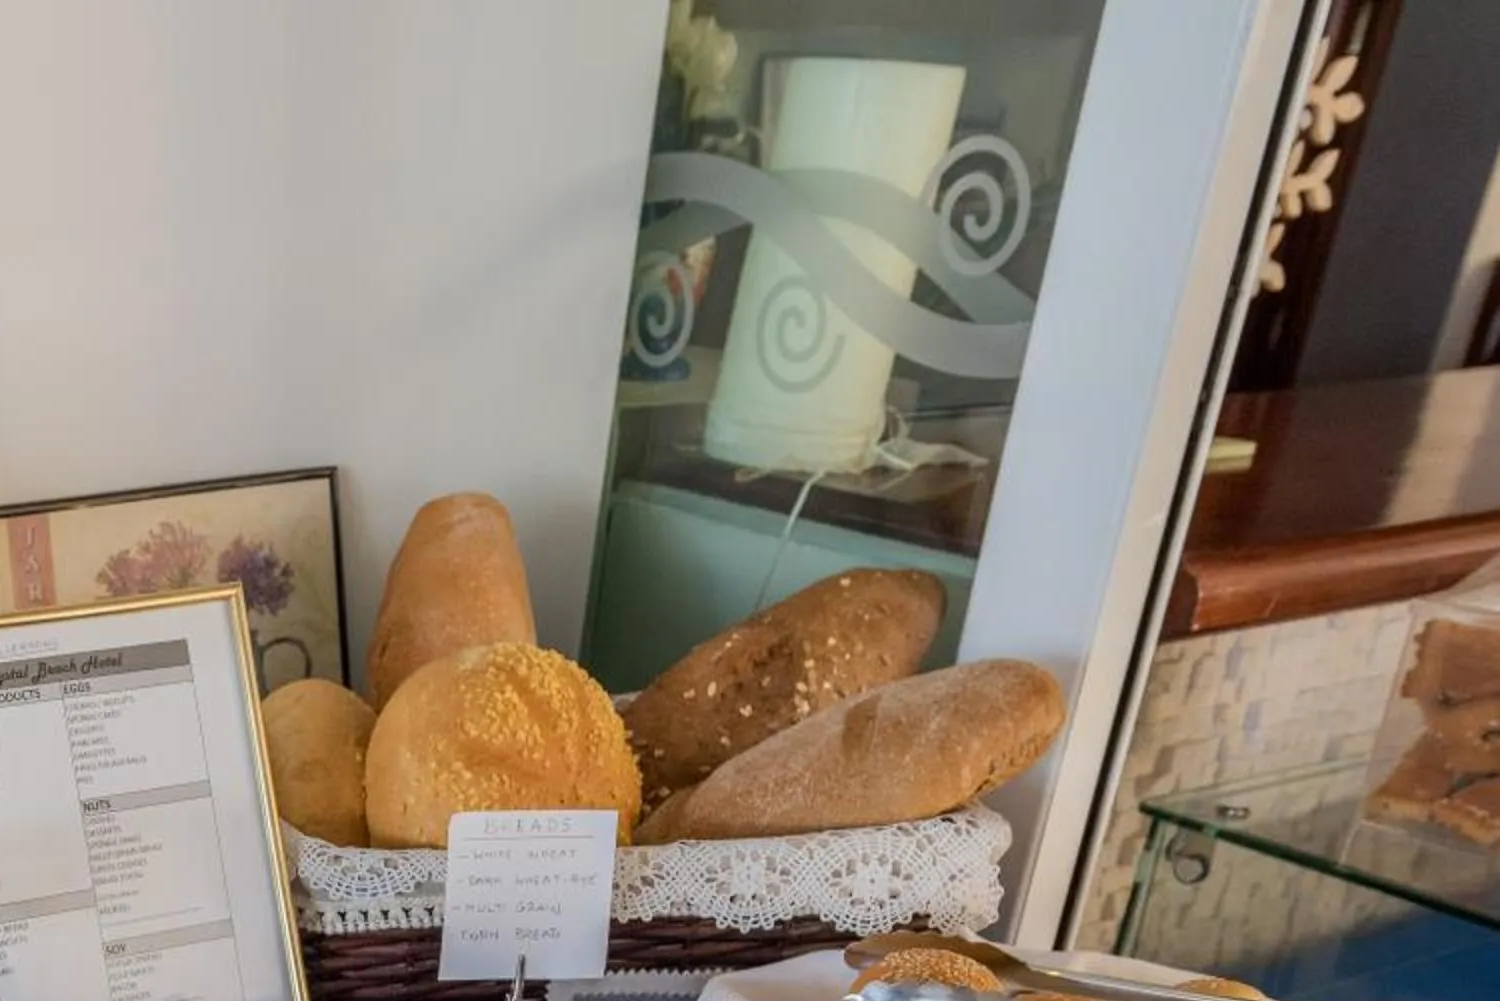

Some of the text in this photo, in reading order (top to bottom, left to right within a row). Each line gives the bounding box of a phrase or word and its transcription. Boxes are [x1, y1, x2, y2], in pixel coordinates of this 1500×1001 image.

[32, 658, 78, 684] Beach
[81, 651, 123, 675] Hotel
[63, 682, 91, 695] EGGS
[83, 799, 112, 813] NUTS
[105, 943, 126, 956] SOY
